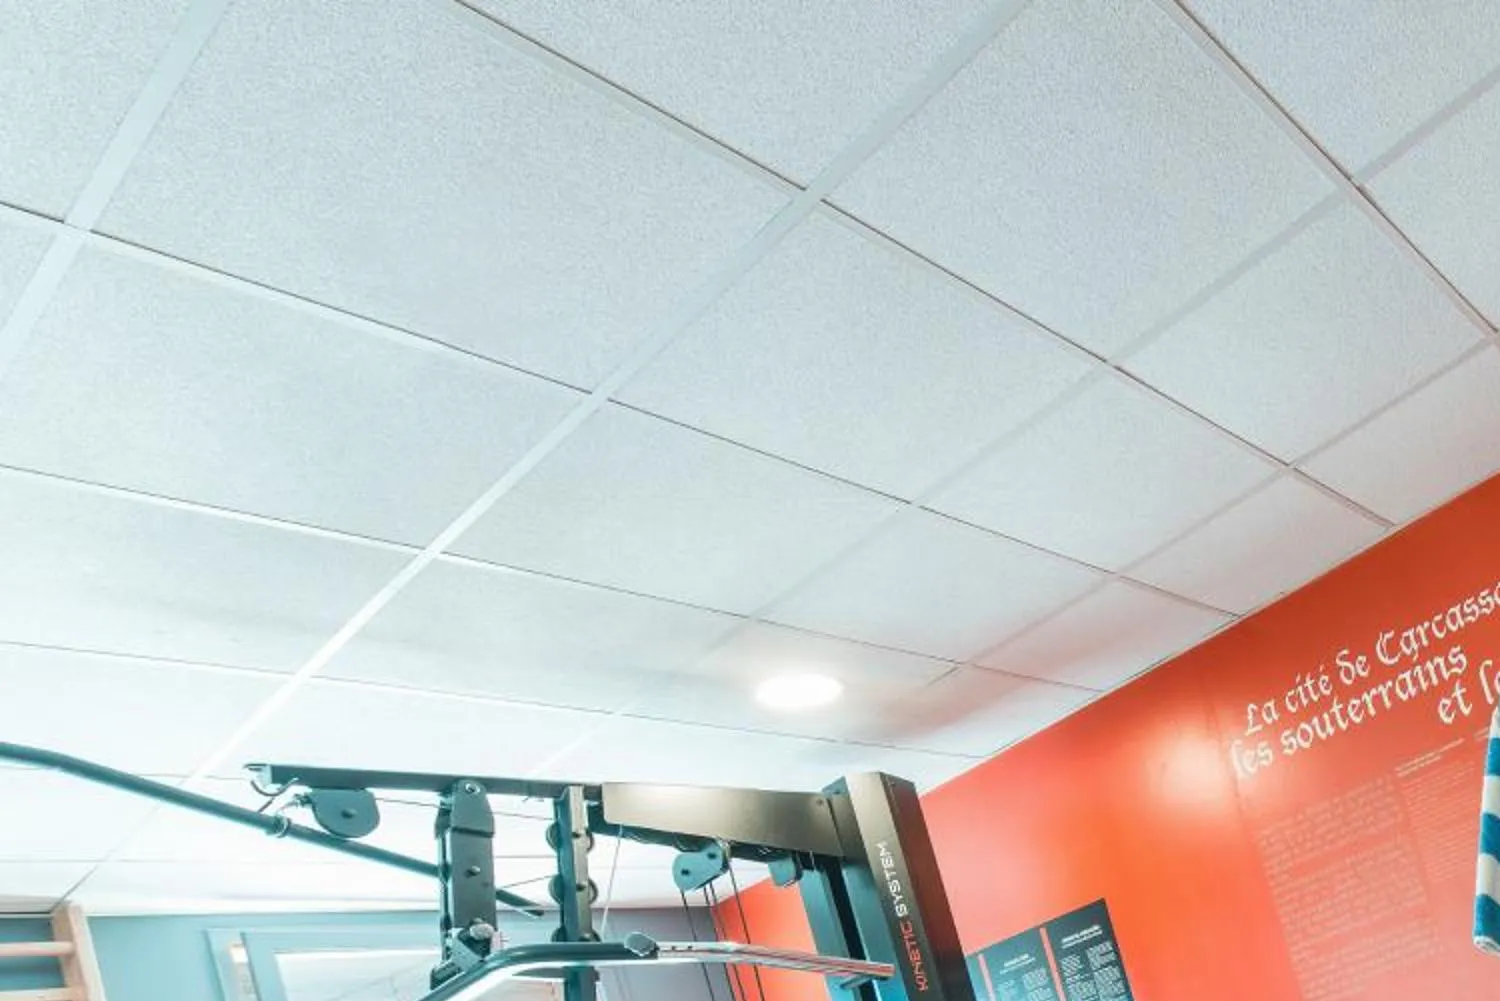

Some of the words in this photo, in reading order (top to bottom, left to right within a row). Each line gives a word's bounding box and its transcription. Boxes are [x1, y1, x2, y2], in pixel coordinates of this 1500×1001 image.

[1230, 738, 1274, 777] les
[1280, 645, 1468, 755] souterrains
[1245, 700, 1280, 736] La
[1285, 664, 1333, 713] cité
[1336, 649, 1370, 685] de
[1438, 679, 1473, 724] et
[876, 840, 908, 917] SYSTEM
[901, 920, 928, 991] KINETIC
